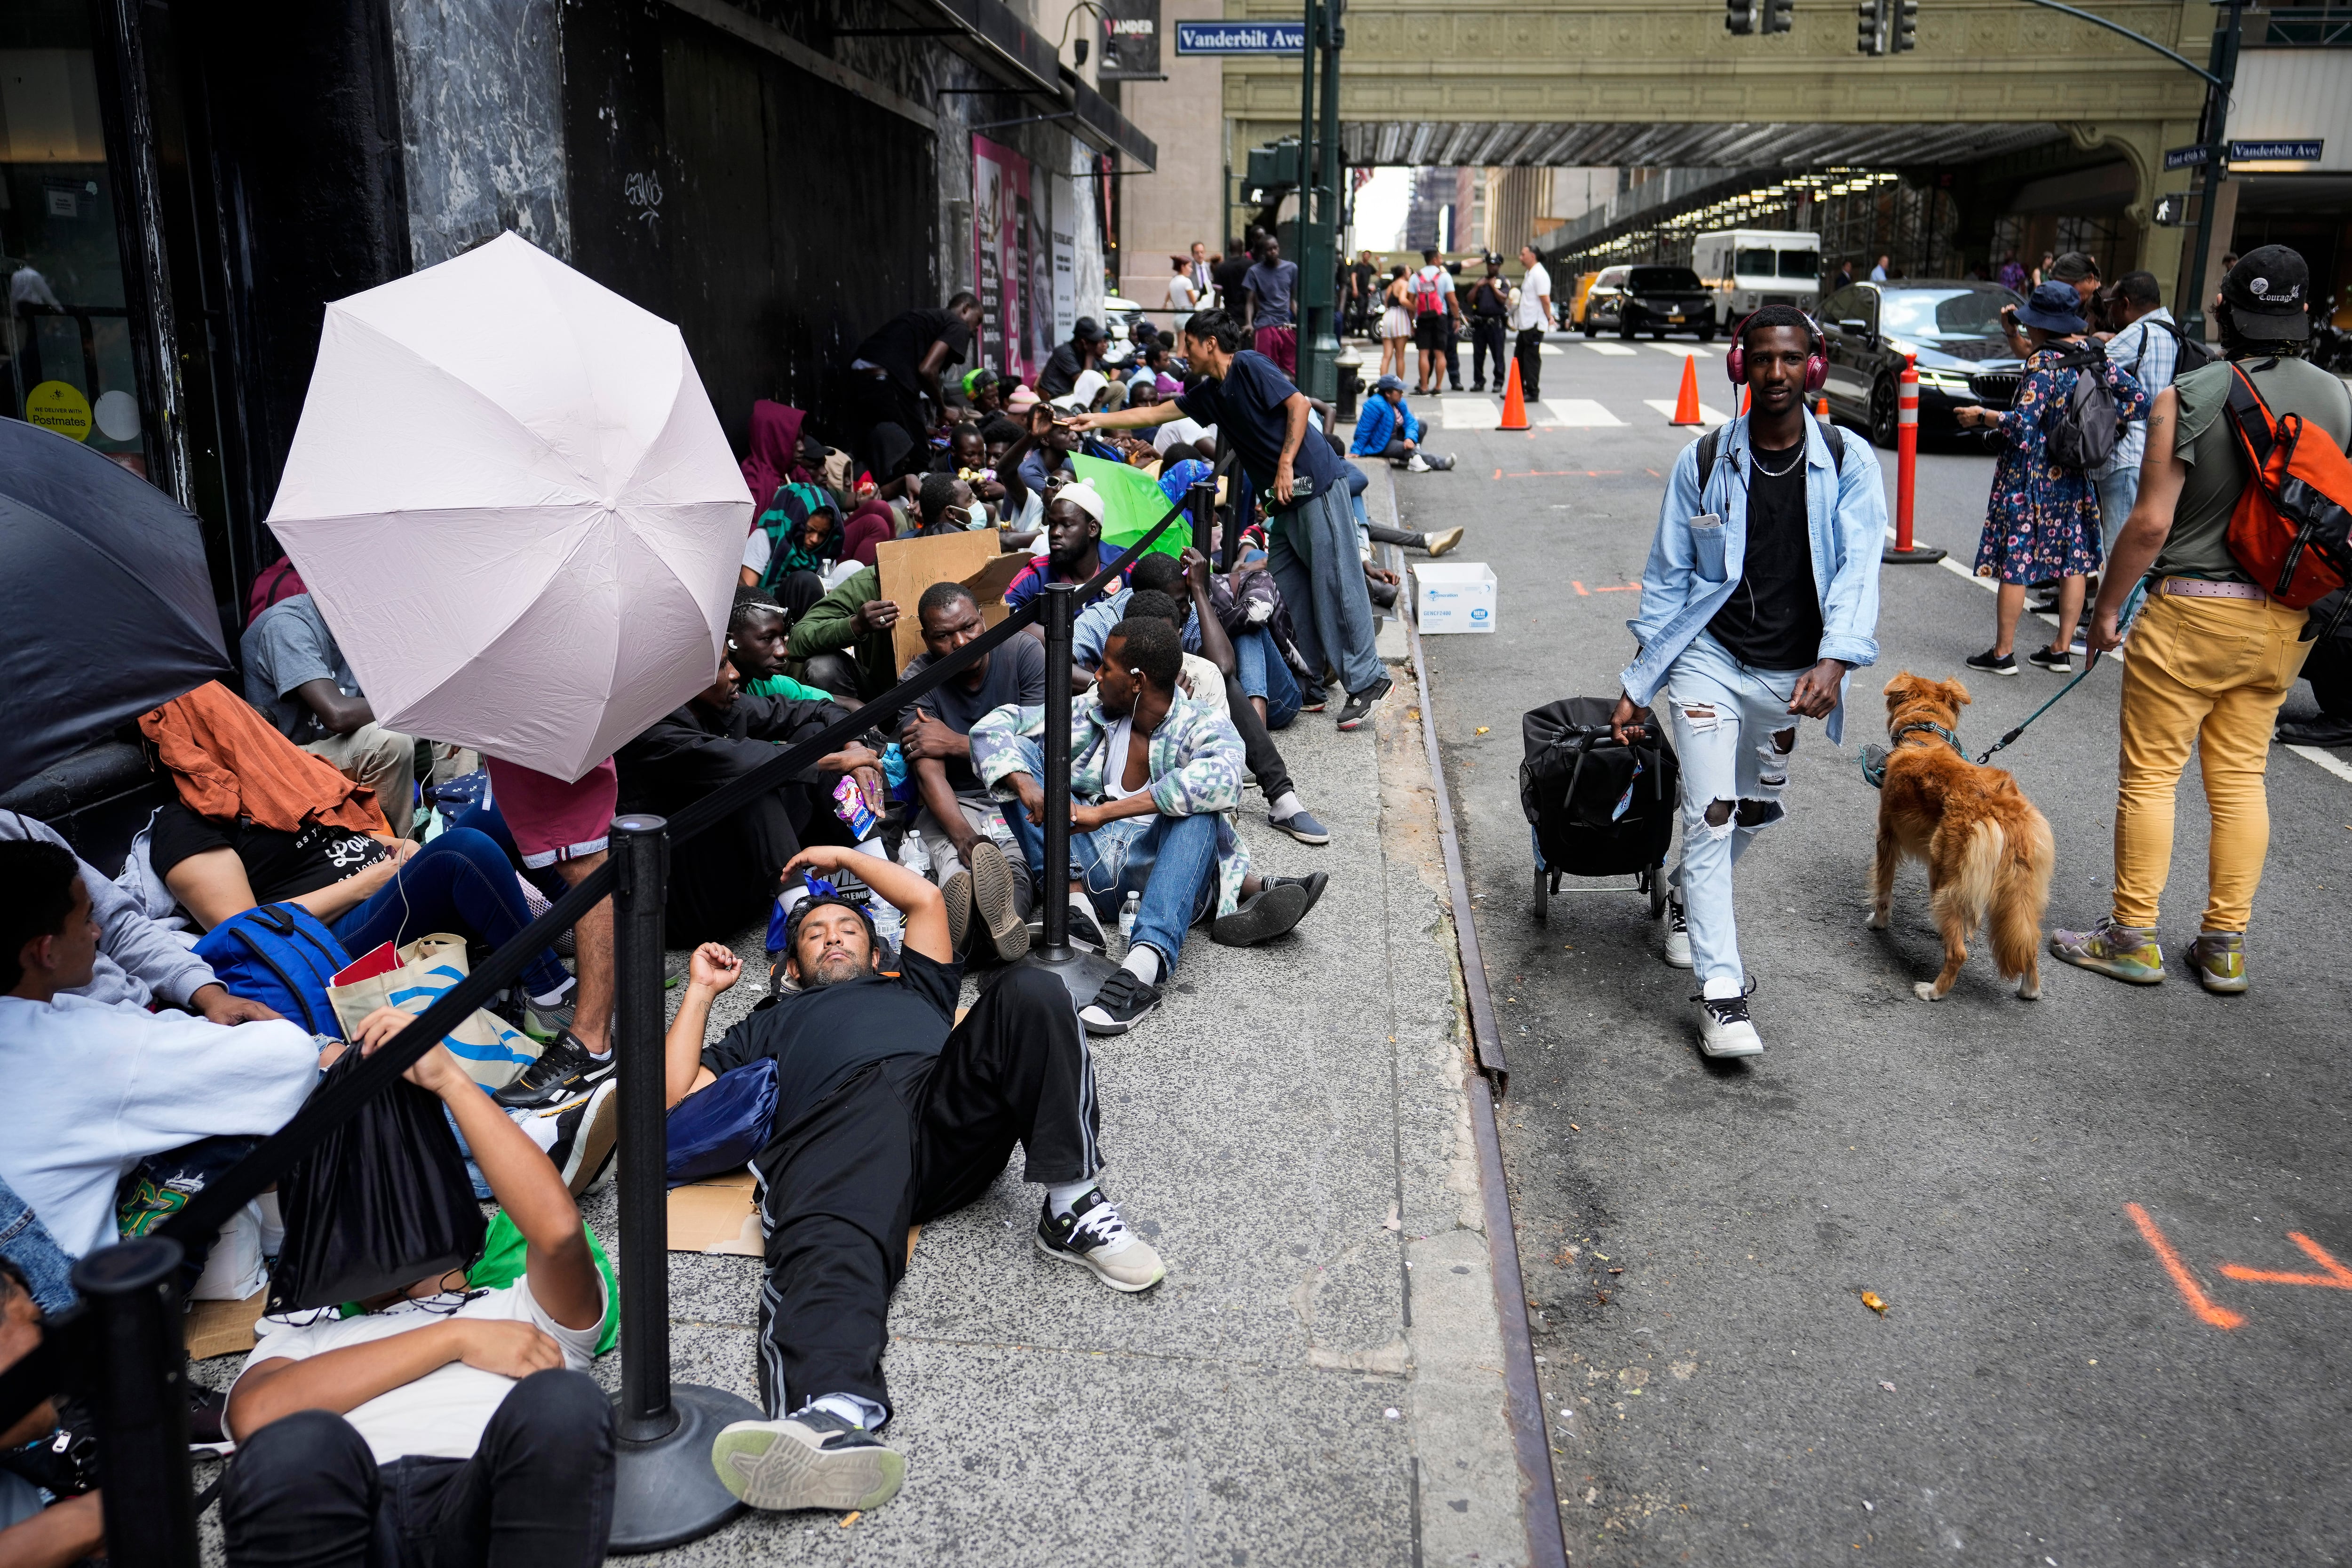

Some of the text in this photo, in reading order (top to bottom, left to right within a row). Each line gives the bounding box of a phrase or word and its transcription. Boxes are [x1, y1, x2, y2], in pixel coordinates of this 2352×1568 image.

[1104, 19, 1153, 36] VANDER
[1182, 30, 1304, 48] Vanderbilt Ave
[2168, 147, 2207, 166] East 45th St
[2235, 144, 2318, 157] Vanderbilt Ave
[2259, 293, 2293, 303] Courage
[33, 414, 86, 427] Postmates
[296, 825, 322, 848] as yo
[565, 1036, 580, 1050] Reebok
[563, 1075, 580, 1085] Reebok
